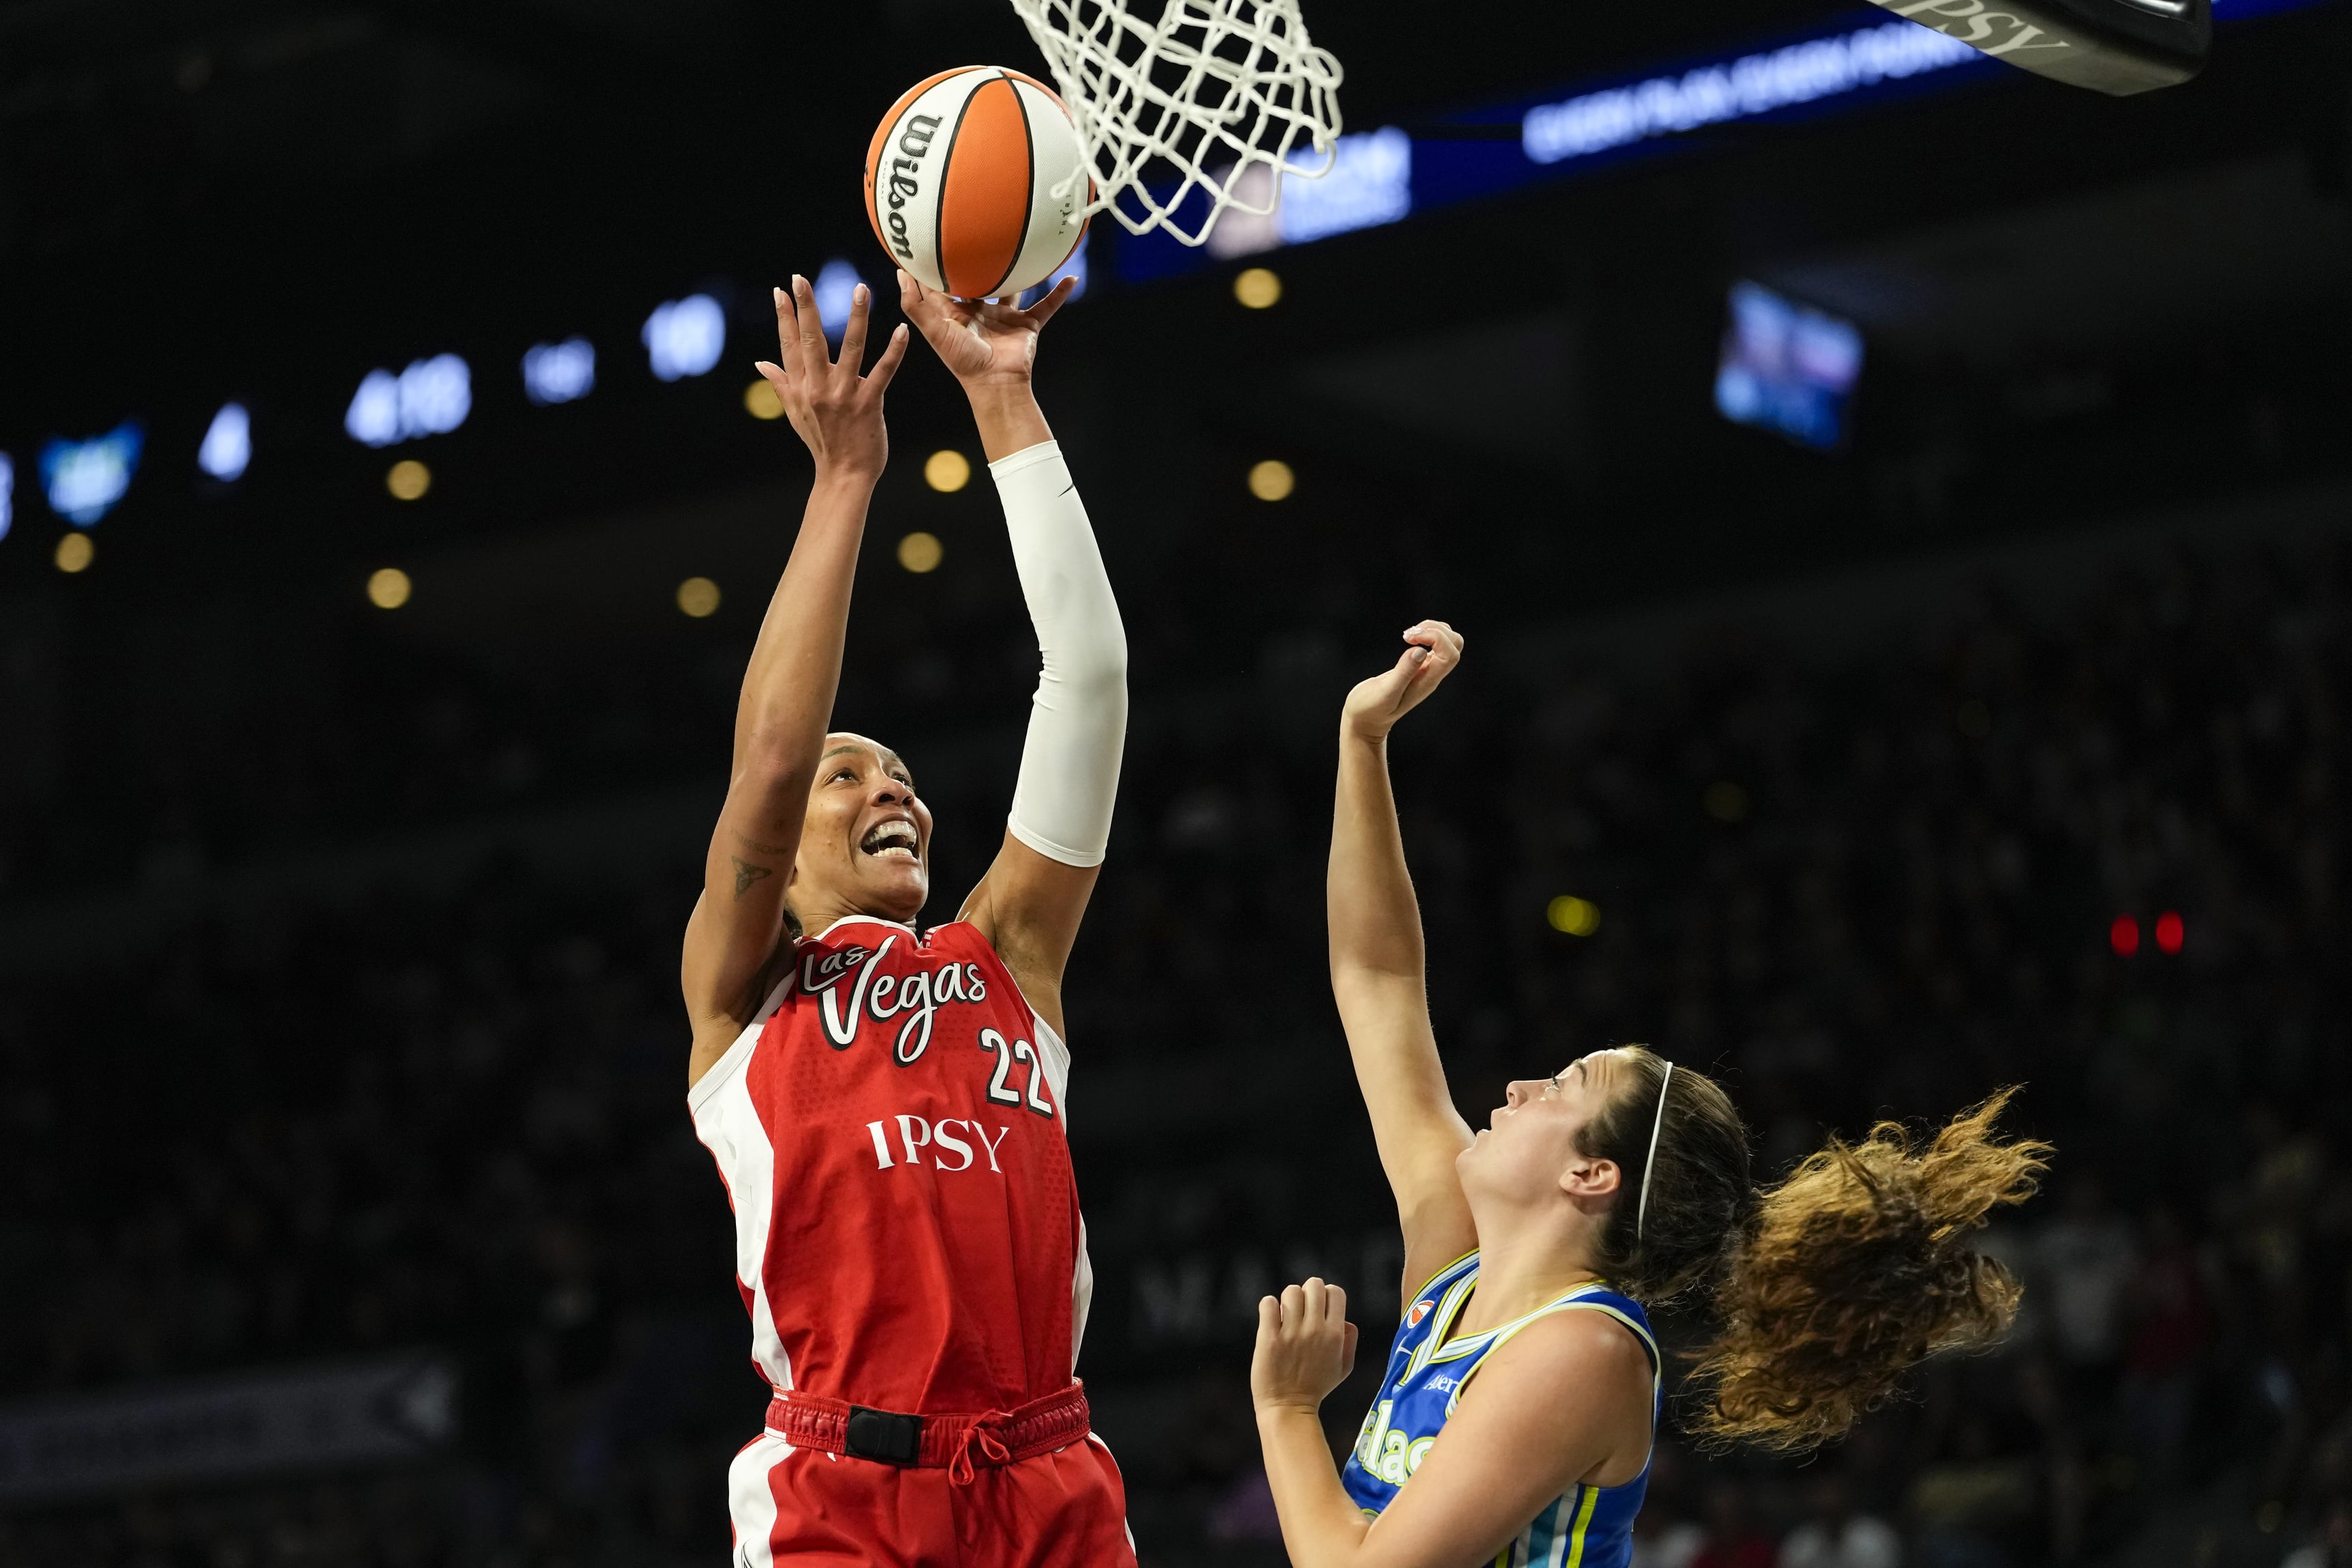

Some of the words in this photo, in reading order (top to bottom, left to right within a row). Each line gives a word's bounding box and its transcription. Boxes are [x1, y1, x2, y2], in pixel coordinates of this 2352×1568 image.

[1867, 0, 2071, 56] PSY
[888, 114, 944, 260] Wilson
[800, 945, 872, 995] Las
[820, 935, 987, 1067] Vegas
[978, 1027, 1053, 1120] 22
[866, 1114, 1010, 1174] IPSY
